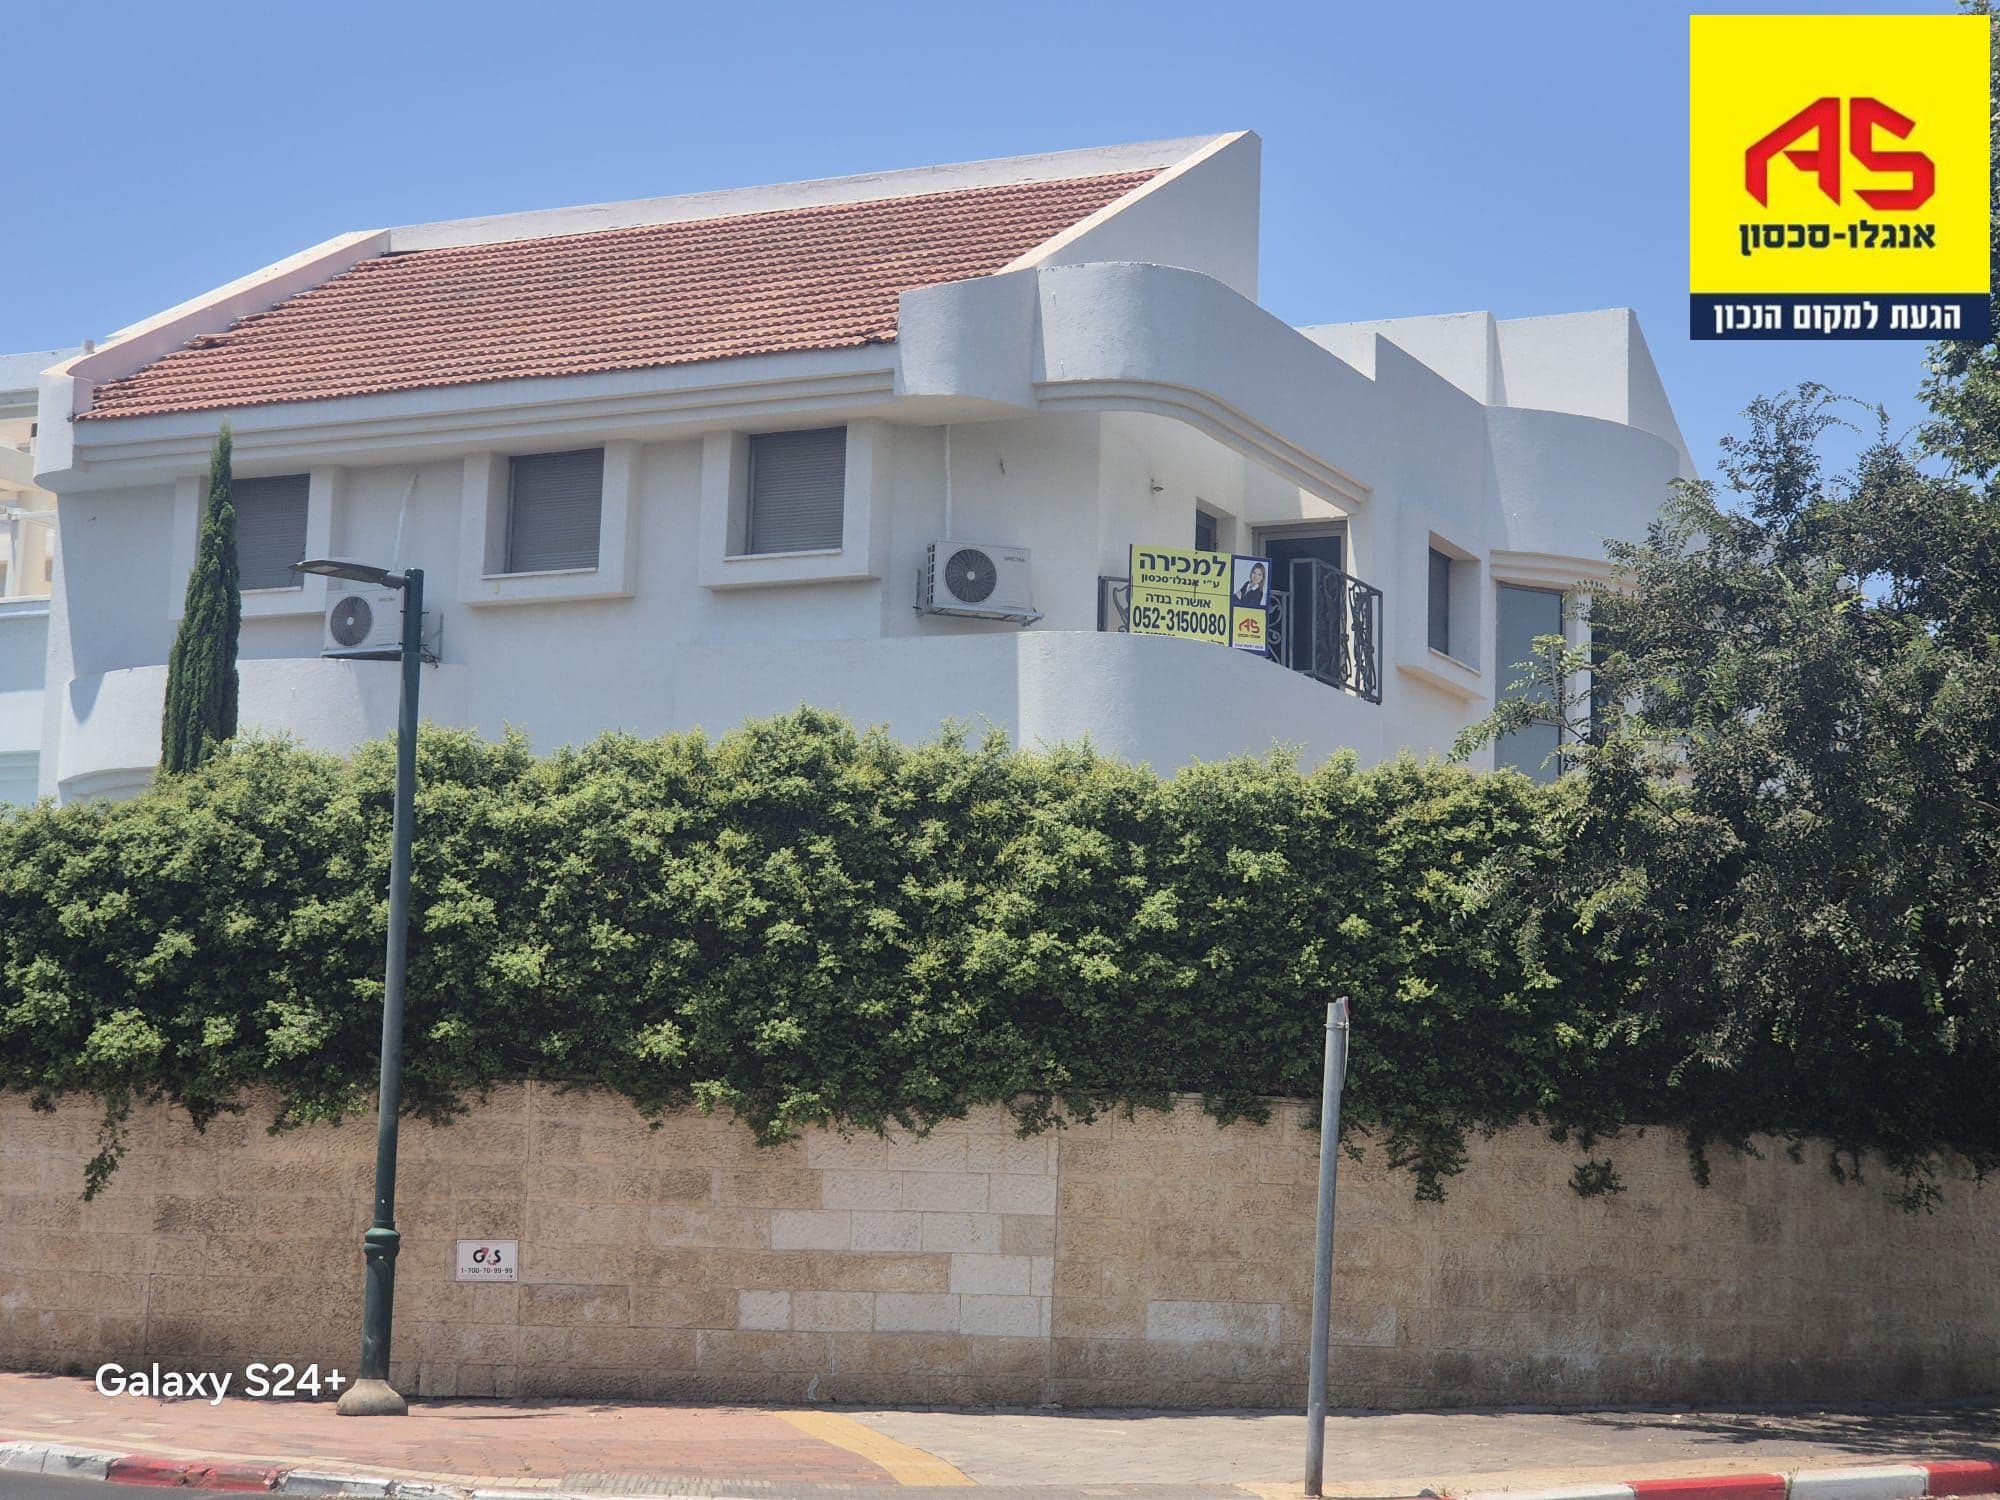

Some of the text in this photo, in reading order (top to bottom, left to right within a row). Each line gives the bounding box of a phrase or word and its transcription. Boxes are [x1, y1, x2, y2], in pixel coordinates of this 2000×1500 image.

[1139, 552, 1227, 577] למכירה
[1176, 596, 1211, 608] אושרה
[1133, 605, 1226, 636] 052-3150080
[1238, 618, 1260, 633] AS
